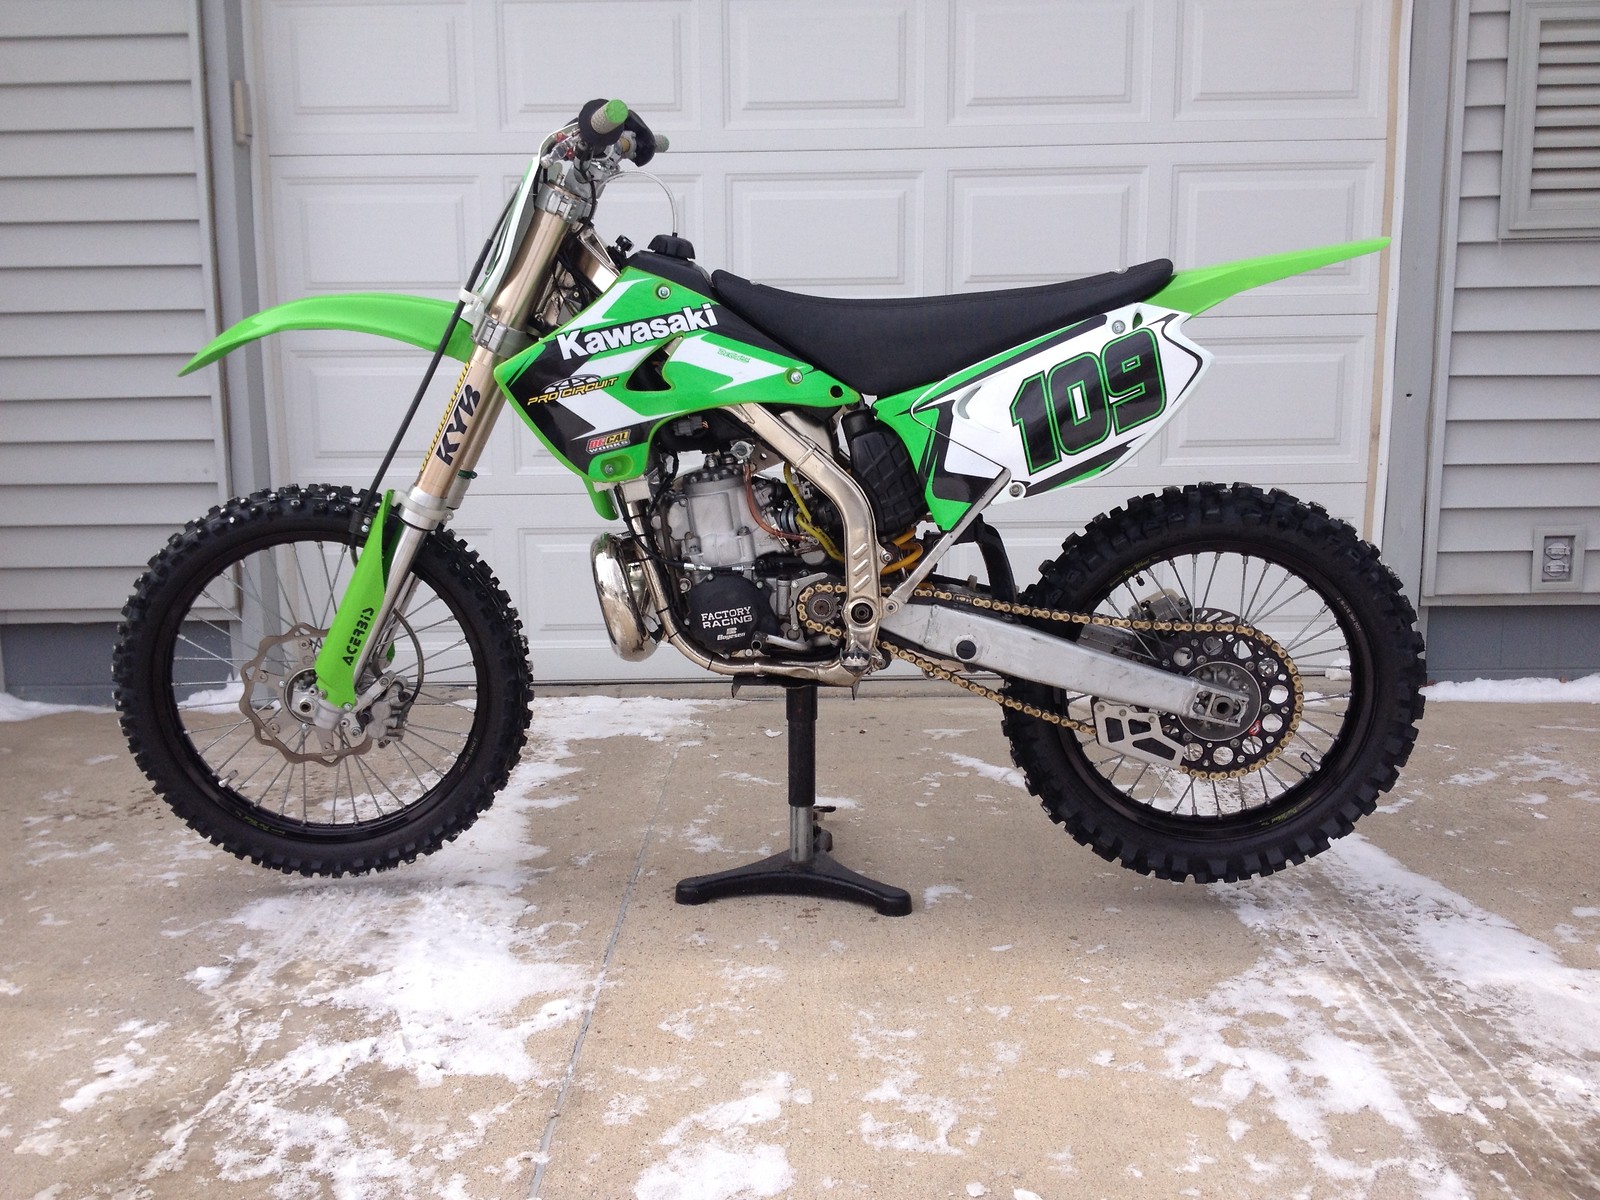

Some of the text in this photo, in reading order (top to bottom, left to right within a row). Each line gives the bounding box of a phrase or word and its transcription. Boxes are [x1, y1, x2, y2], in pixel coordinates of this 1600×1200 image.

[556, 303, 718, 360] Kawasaki
[527, 377, 618, 406] PRO CIRCUIT
[1010, 327, 1167, 475] 109
[436, 384, 480, 466] KYB
[701, 606, 751, 621] FACTORY
[702, 614, 753, 629] RACING
